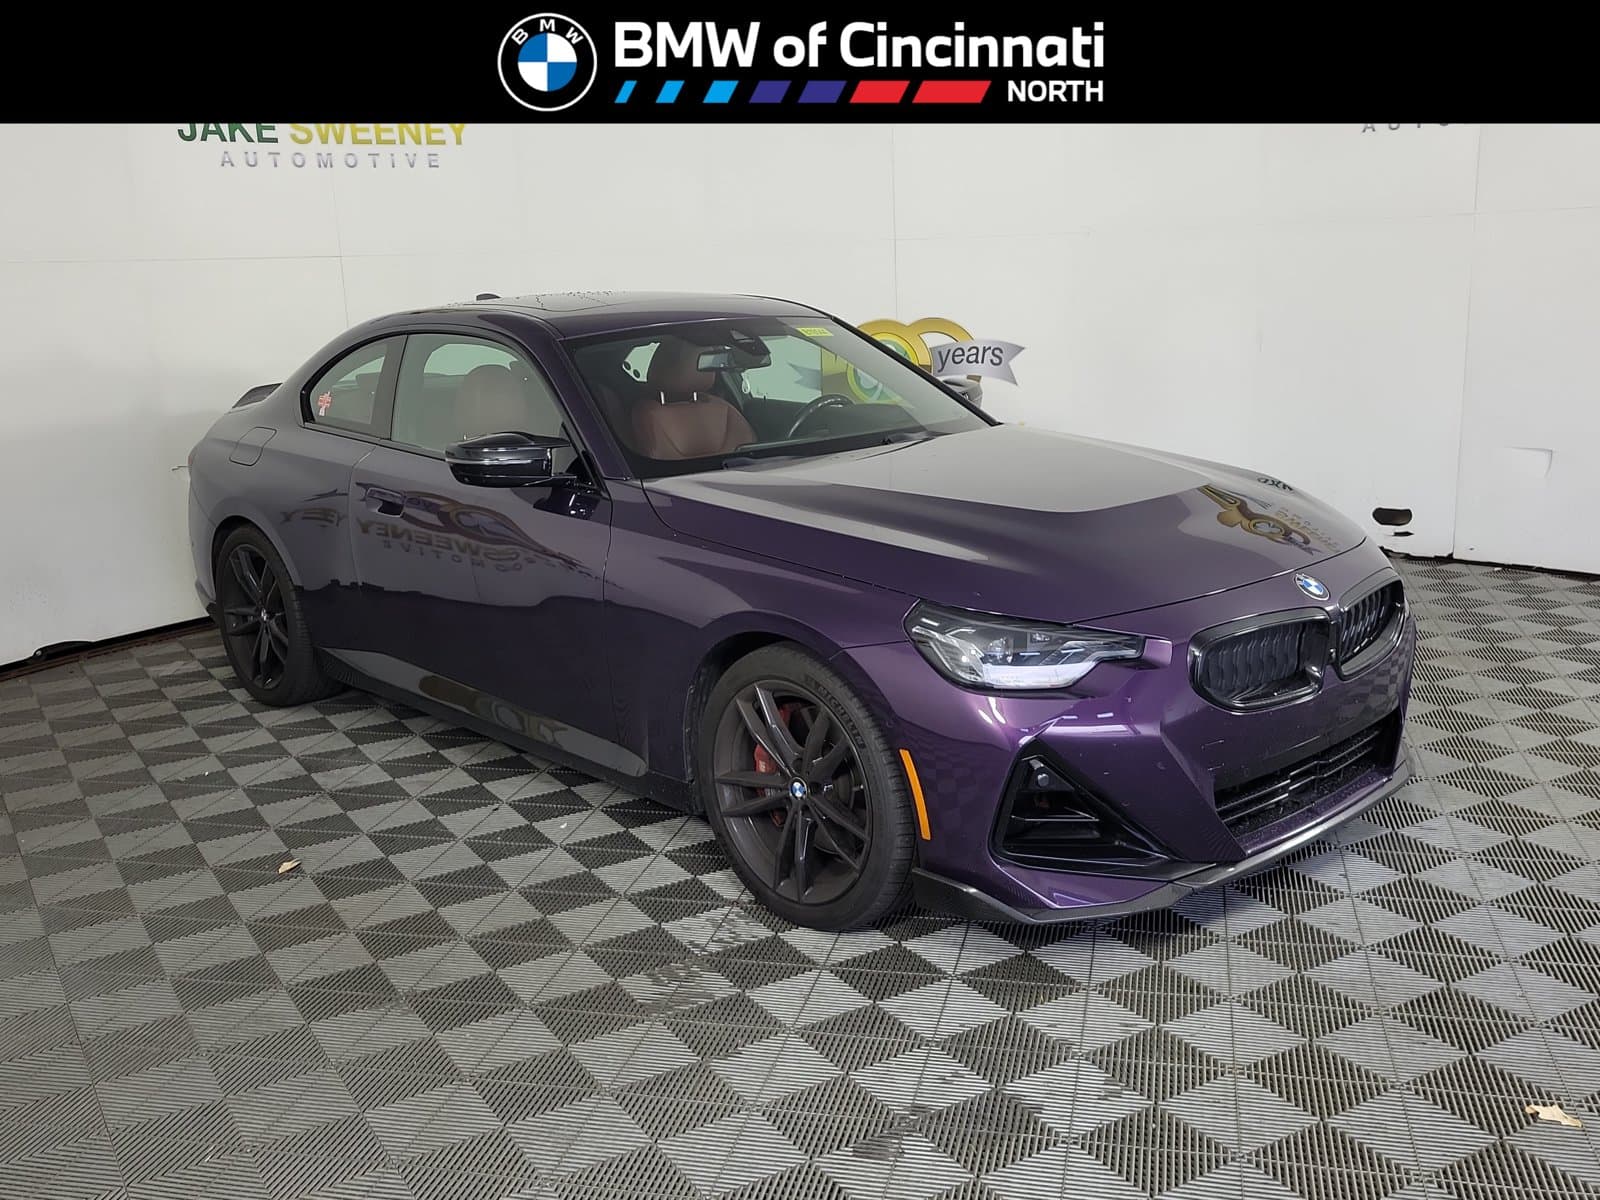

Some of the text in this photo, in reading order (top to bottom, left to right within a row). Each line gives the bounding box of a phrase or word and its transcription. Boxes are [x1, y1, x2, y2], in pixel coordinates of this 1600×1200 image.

[176, 123, 467, 146] JAKE SWEENEY
[220, 150, 440, 169] AUTOMOTIVE
[936, 345, 1004, 373] years
